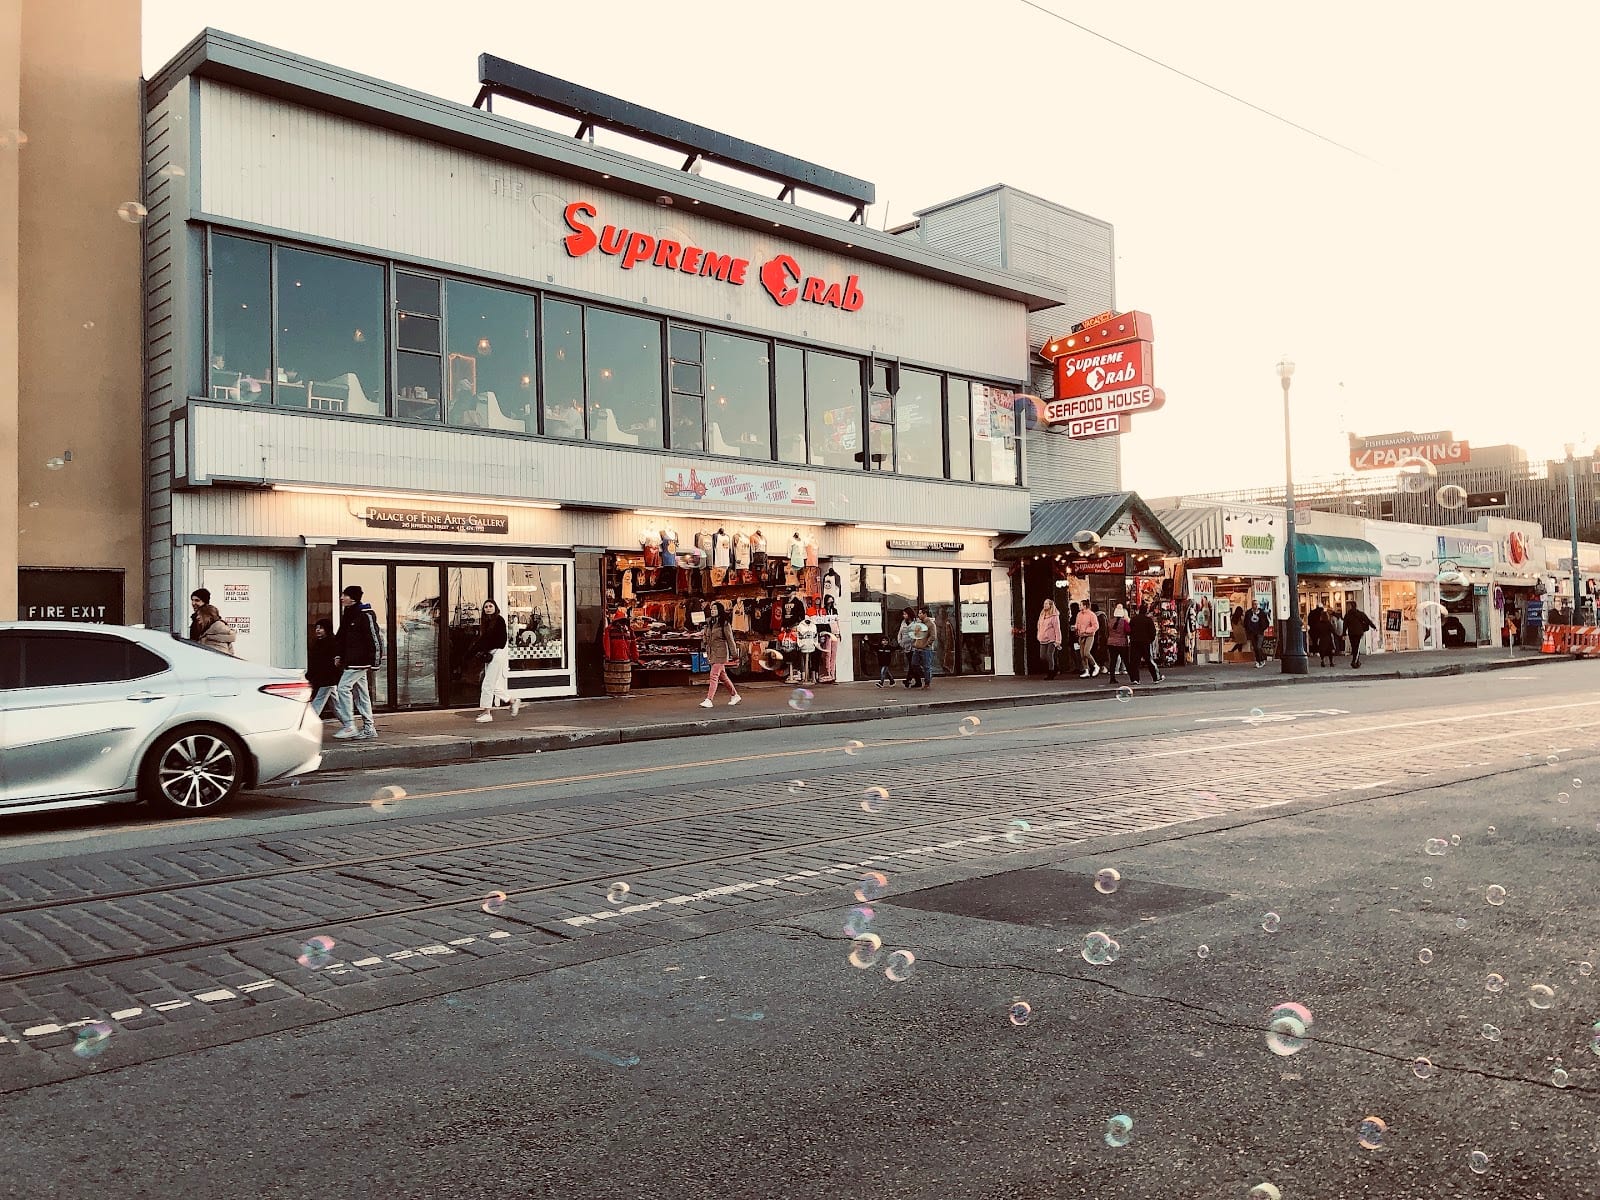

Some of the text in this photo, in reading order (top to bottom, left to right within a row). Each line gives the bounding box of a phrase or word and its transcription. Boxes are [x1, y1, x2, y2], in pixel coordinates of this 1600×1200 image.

[564, 201, 750, 286] SUPREME
[1066, 352, 1124, 378] SUPREME
[1048, 389, 1151, 419] SEAFOOD HOUSE
[1072, 417, 1117, 436] OPEN
[1373, 443, 1461, 466] PARKING
[370, 509, 505, 528] PALACE OF FINE ARTS GALLERY
[1194, 580, 1212, 593] WOW!
[29, 606, 106, 618] FIRE EXIT
